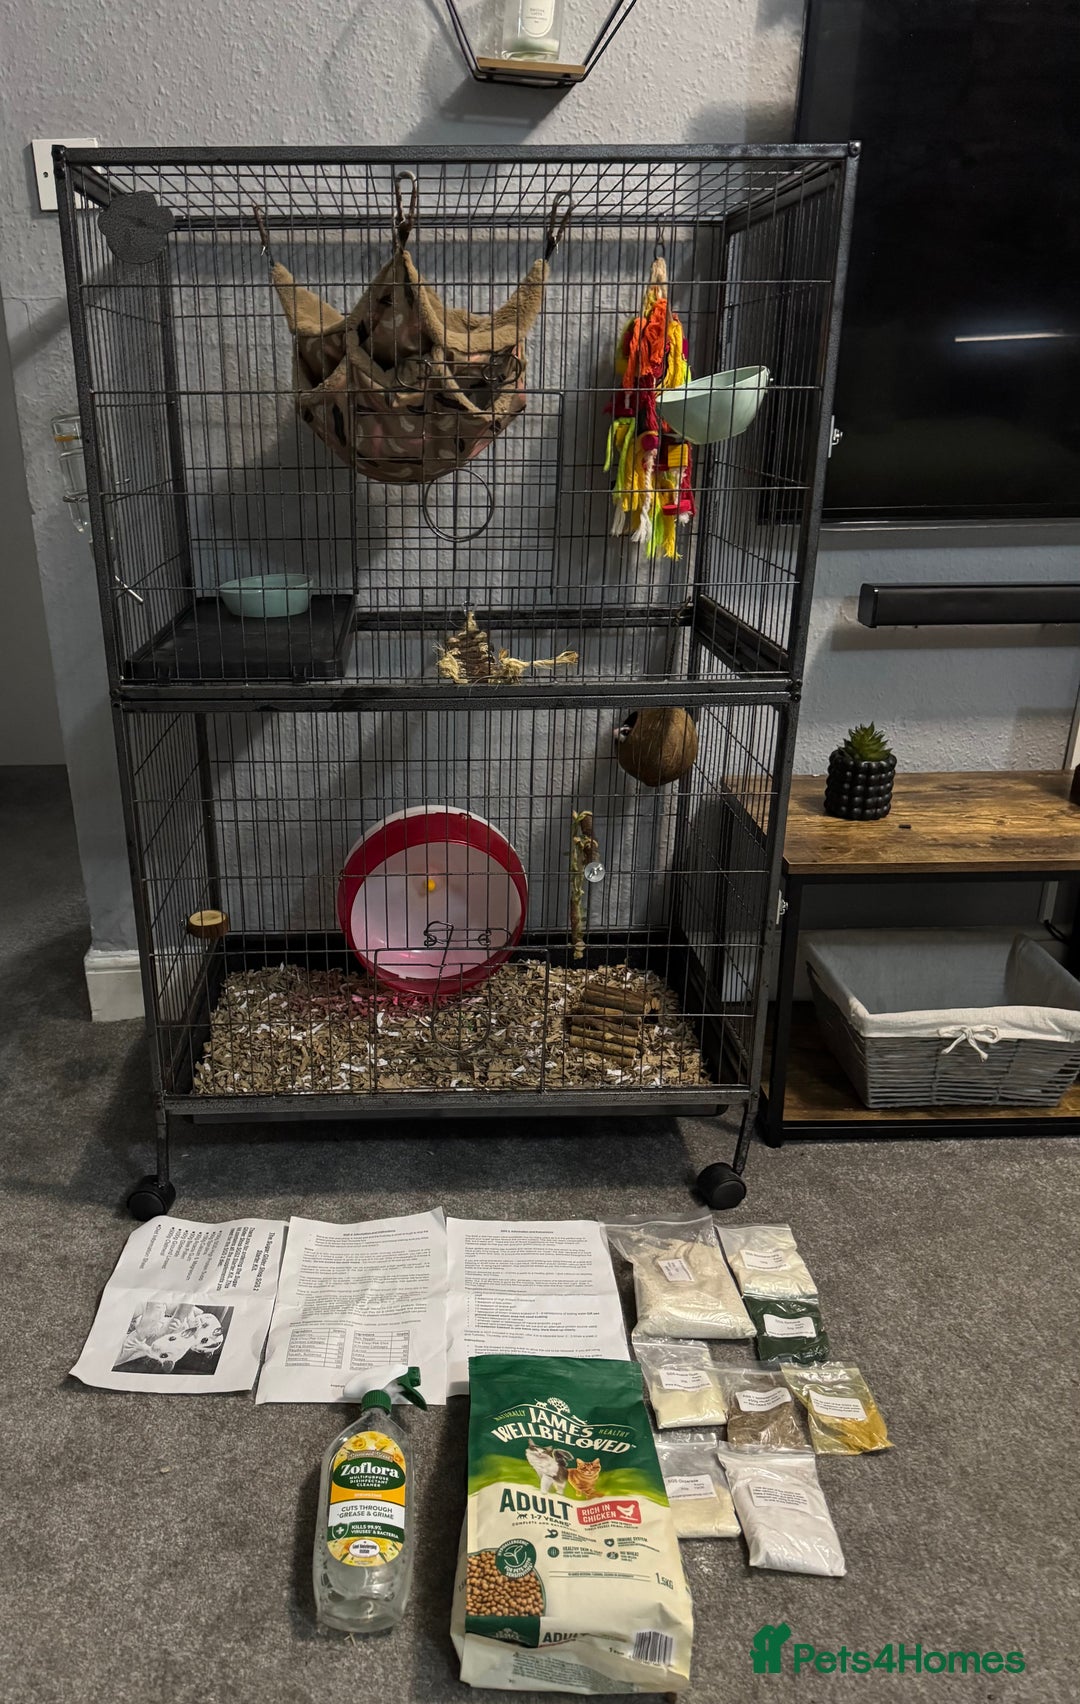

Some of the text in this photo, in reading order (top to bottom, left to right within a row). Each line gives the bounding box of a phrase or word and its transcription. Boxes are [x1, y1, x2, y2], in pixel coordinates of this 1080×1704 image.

[240, 1226, 248, 1236] Glider
[247, 1227, 255, 1236] Thank
[144, 1234, 157, 1257] Information
[263, 1240, 272, 1253] Sugar
[139, 1257, 148, 1268] Sheet
[237, 1251, 246, 1267] ordering
[253, 1250, 262, 1263] Starter
[260, 1253, 269, 1265] Glider
[229, 1258, 238, 1271] Starter
[257, 1267, 265, 1277] Shop
[231, 1275, 240, 1287] Sugar
[493, 1410, 526, 1422] NATURALLY
[529, 1407, 594, 1438] JAMES
[491, 1422, 630, 1454] WELLBELOVED
[598, 1429, 630, 1438] HEALTHY
[340, 1462, 400, 1478] Zoflora
[360, 1505, 393, 1513] THROUGH
[499, 1488, 573, 1521] ADULT
[582, 1504, 610, 1517] RICH IN
[372, 1512, 394, 1520] GRIME
[583, 1511, 617, 1524] CHICKEN
[377, 1530, 399, 1539] BACTERIA
